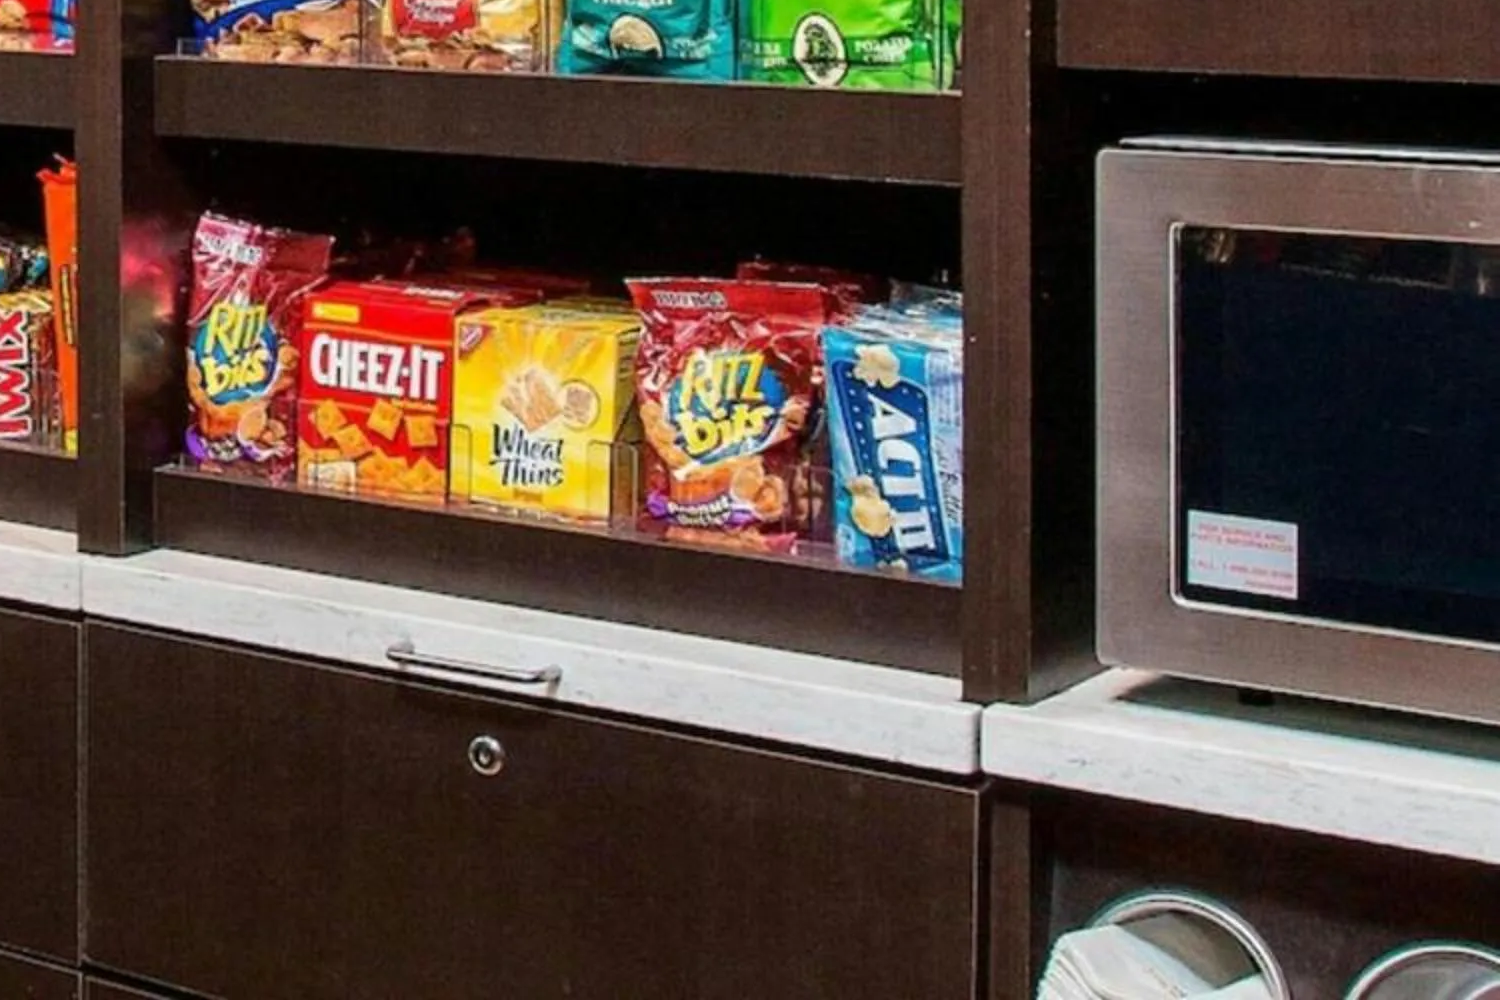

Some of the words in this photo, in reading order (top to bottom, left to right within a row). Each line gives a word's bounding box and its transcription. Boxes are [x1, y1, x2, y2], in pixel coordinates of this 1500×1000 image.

[200, 349, 269, 397] bits
[677, 351, 766, 417] RITZ
[490, 423, 564, 464] Wheat
[676, 404, 774, 454] bits
[866, 392, 927, 501] ACT
[488, 457, 565, 488] Thins
[892, 504, 937, 552] II
